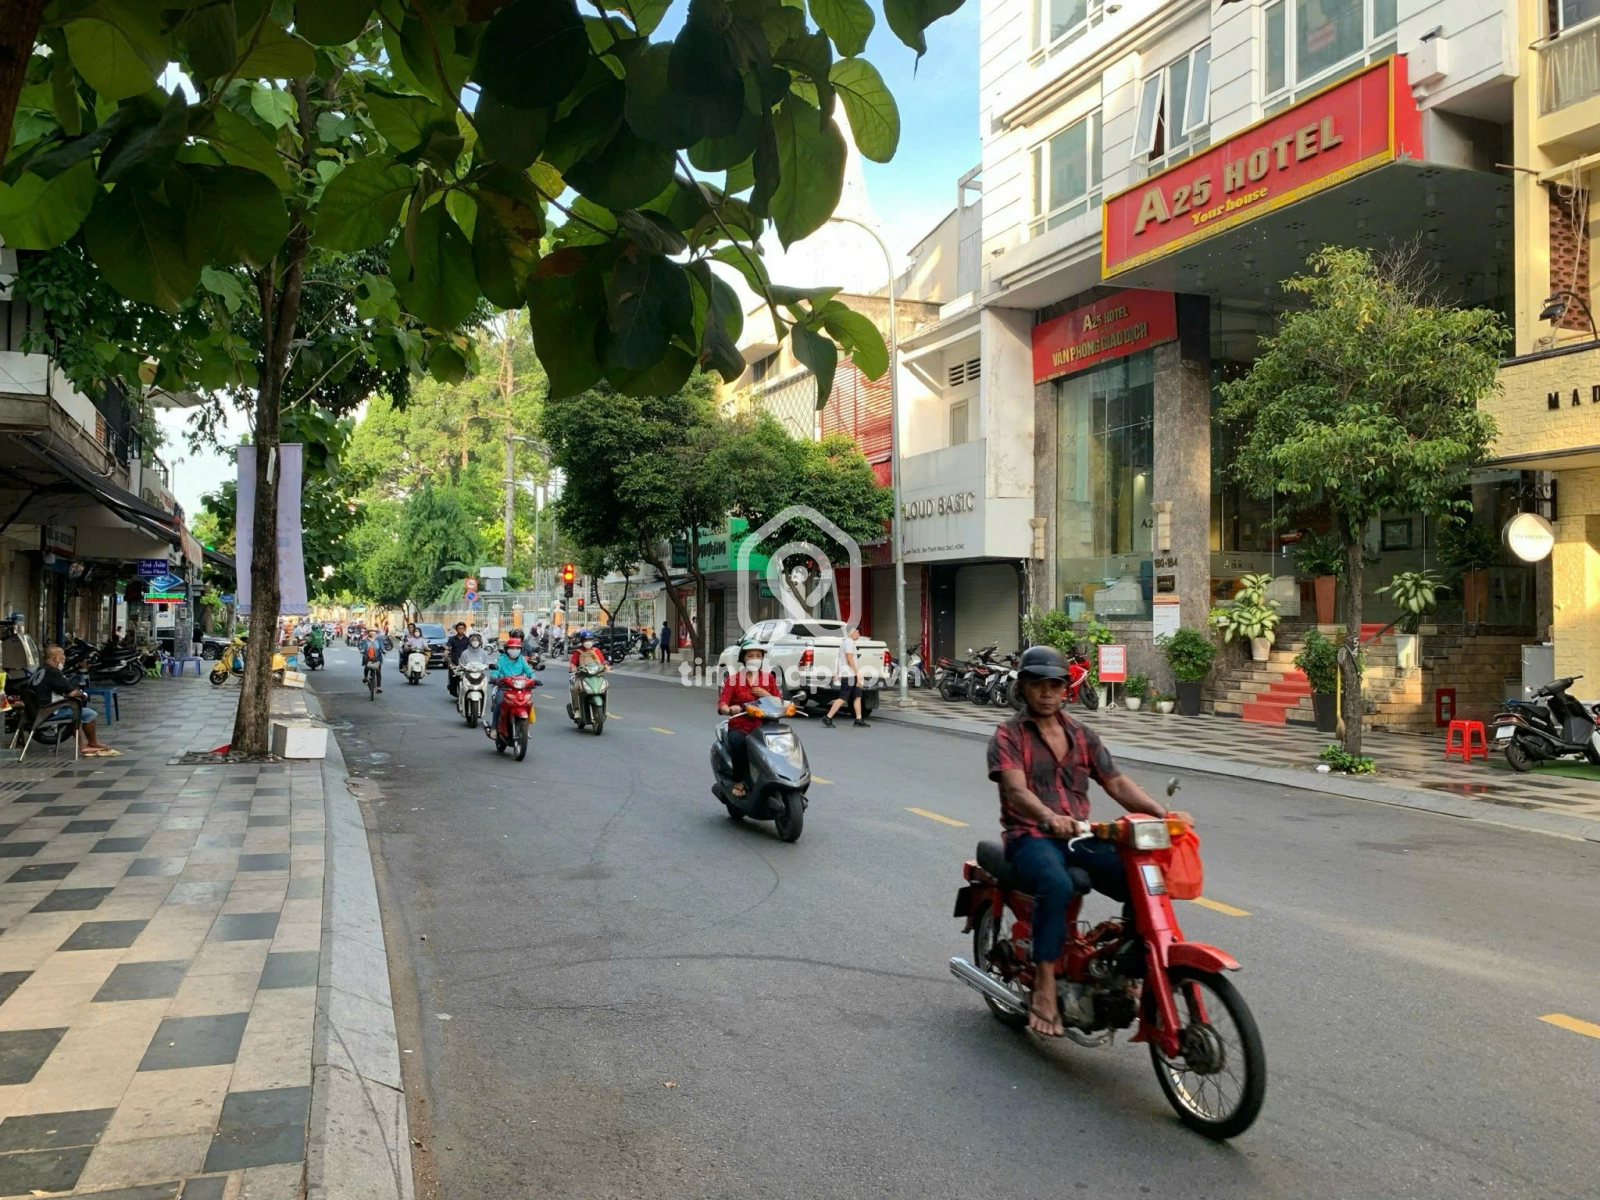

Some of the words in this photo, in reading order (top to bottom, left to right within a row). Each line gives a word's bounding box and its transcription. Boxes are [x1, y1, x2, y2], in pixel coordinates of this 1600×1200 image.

[1132, 174, 1212, 236] A25
[1223, 115, 1343, 194] HOTEL
[1190, 206, 1225, 226] Your
[1225, 186, 1269, 212] house
[1083, 314, 1101, 332] A25
[1103, 306, 1128, 323] HOTEL
[1100, 331, 1123, 350] GIAO
[938, 491, 976, 516] BASIC
